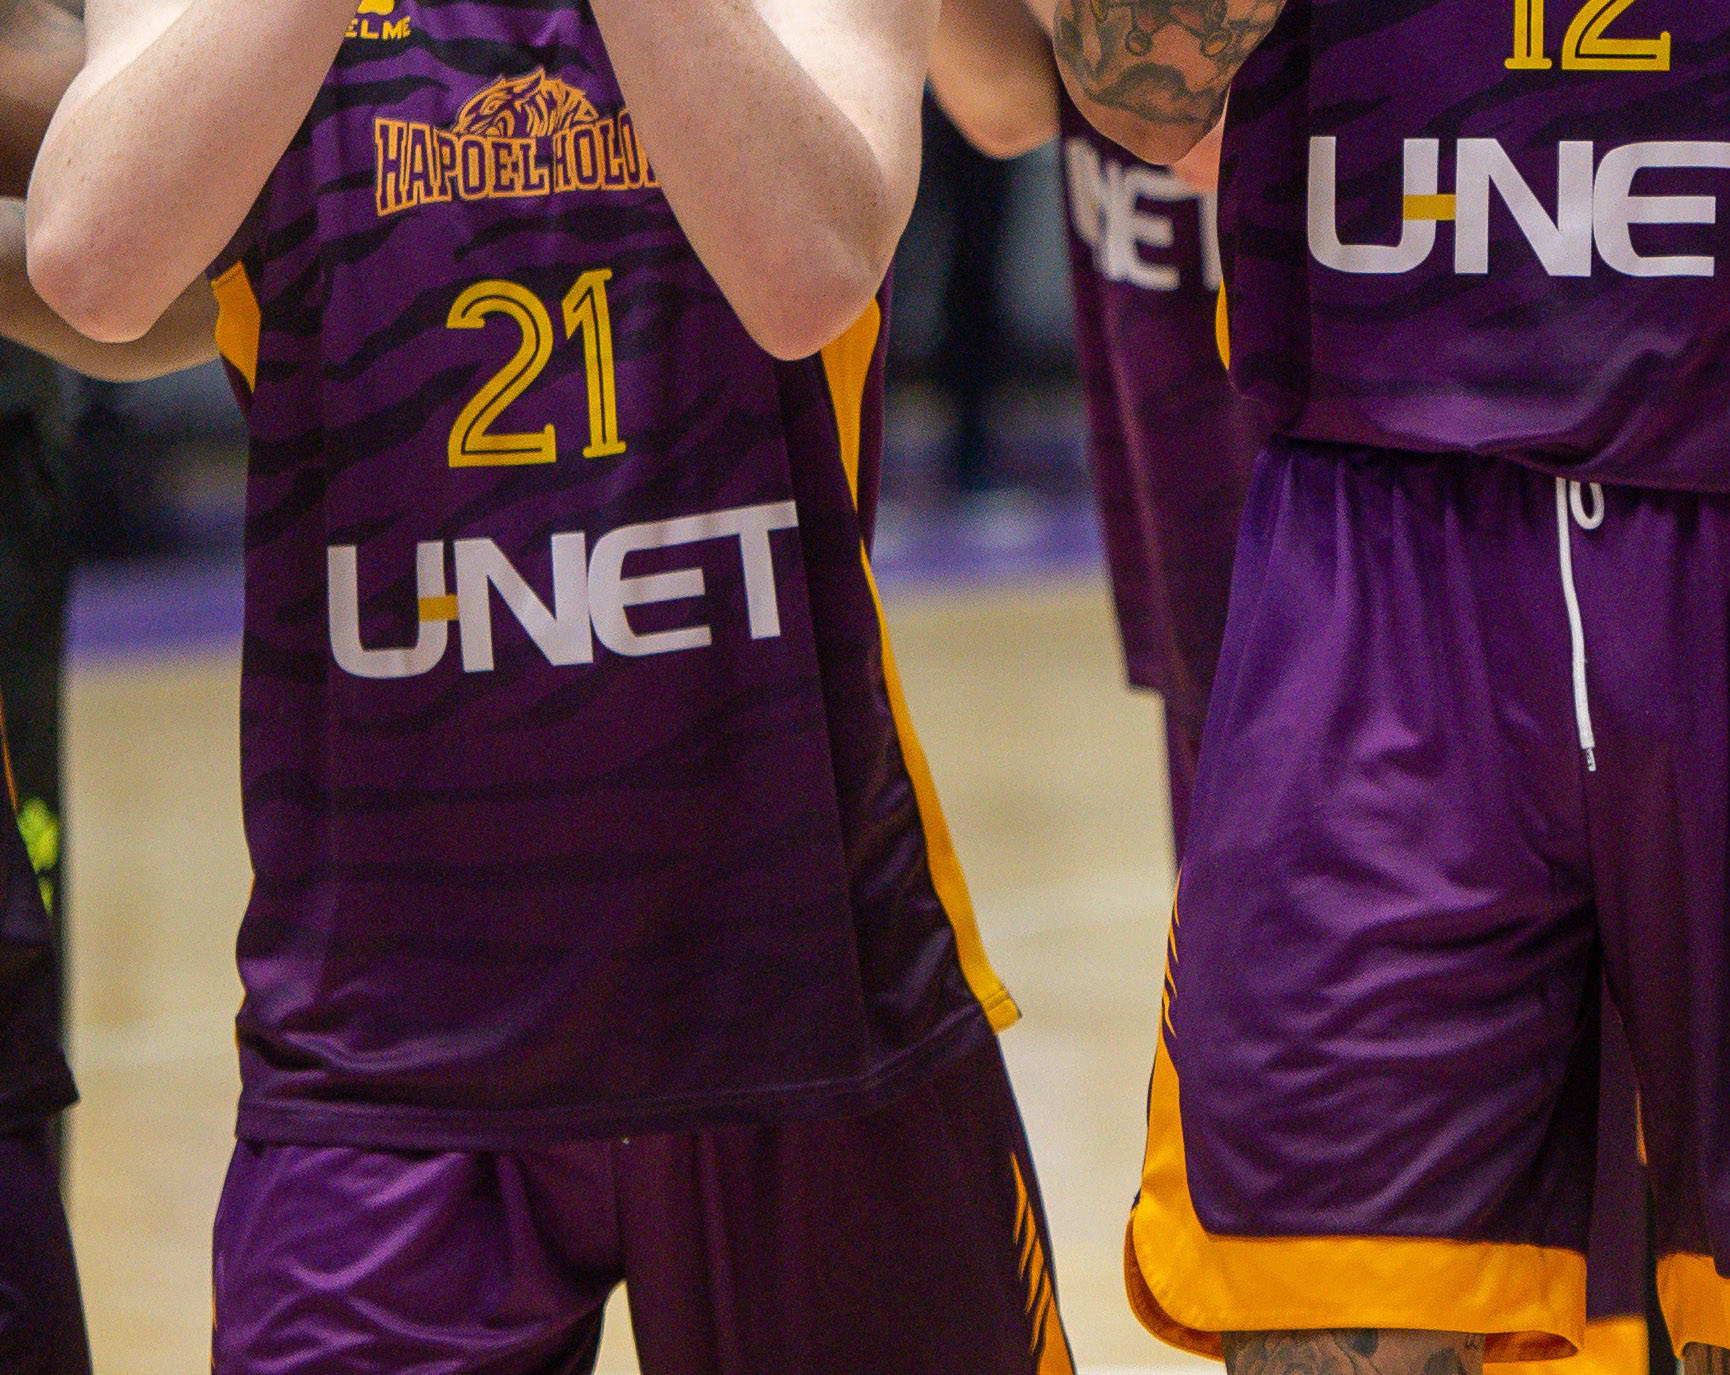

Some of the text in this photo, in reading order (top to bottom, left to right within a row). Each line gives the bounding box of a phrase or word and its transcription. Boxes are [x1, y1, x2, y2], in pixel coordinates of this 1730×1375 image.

[345, 16, 411, 40] ELME
[374, 109, 661, 217] HAPOEL HOLO
[446, 267, 627, 469] 21
